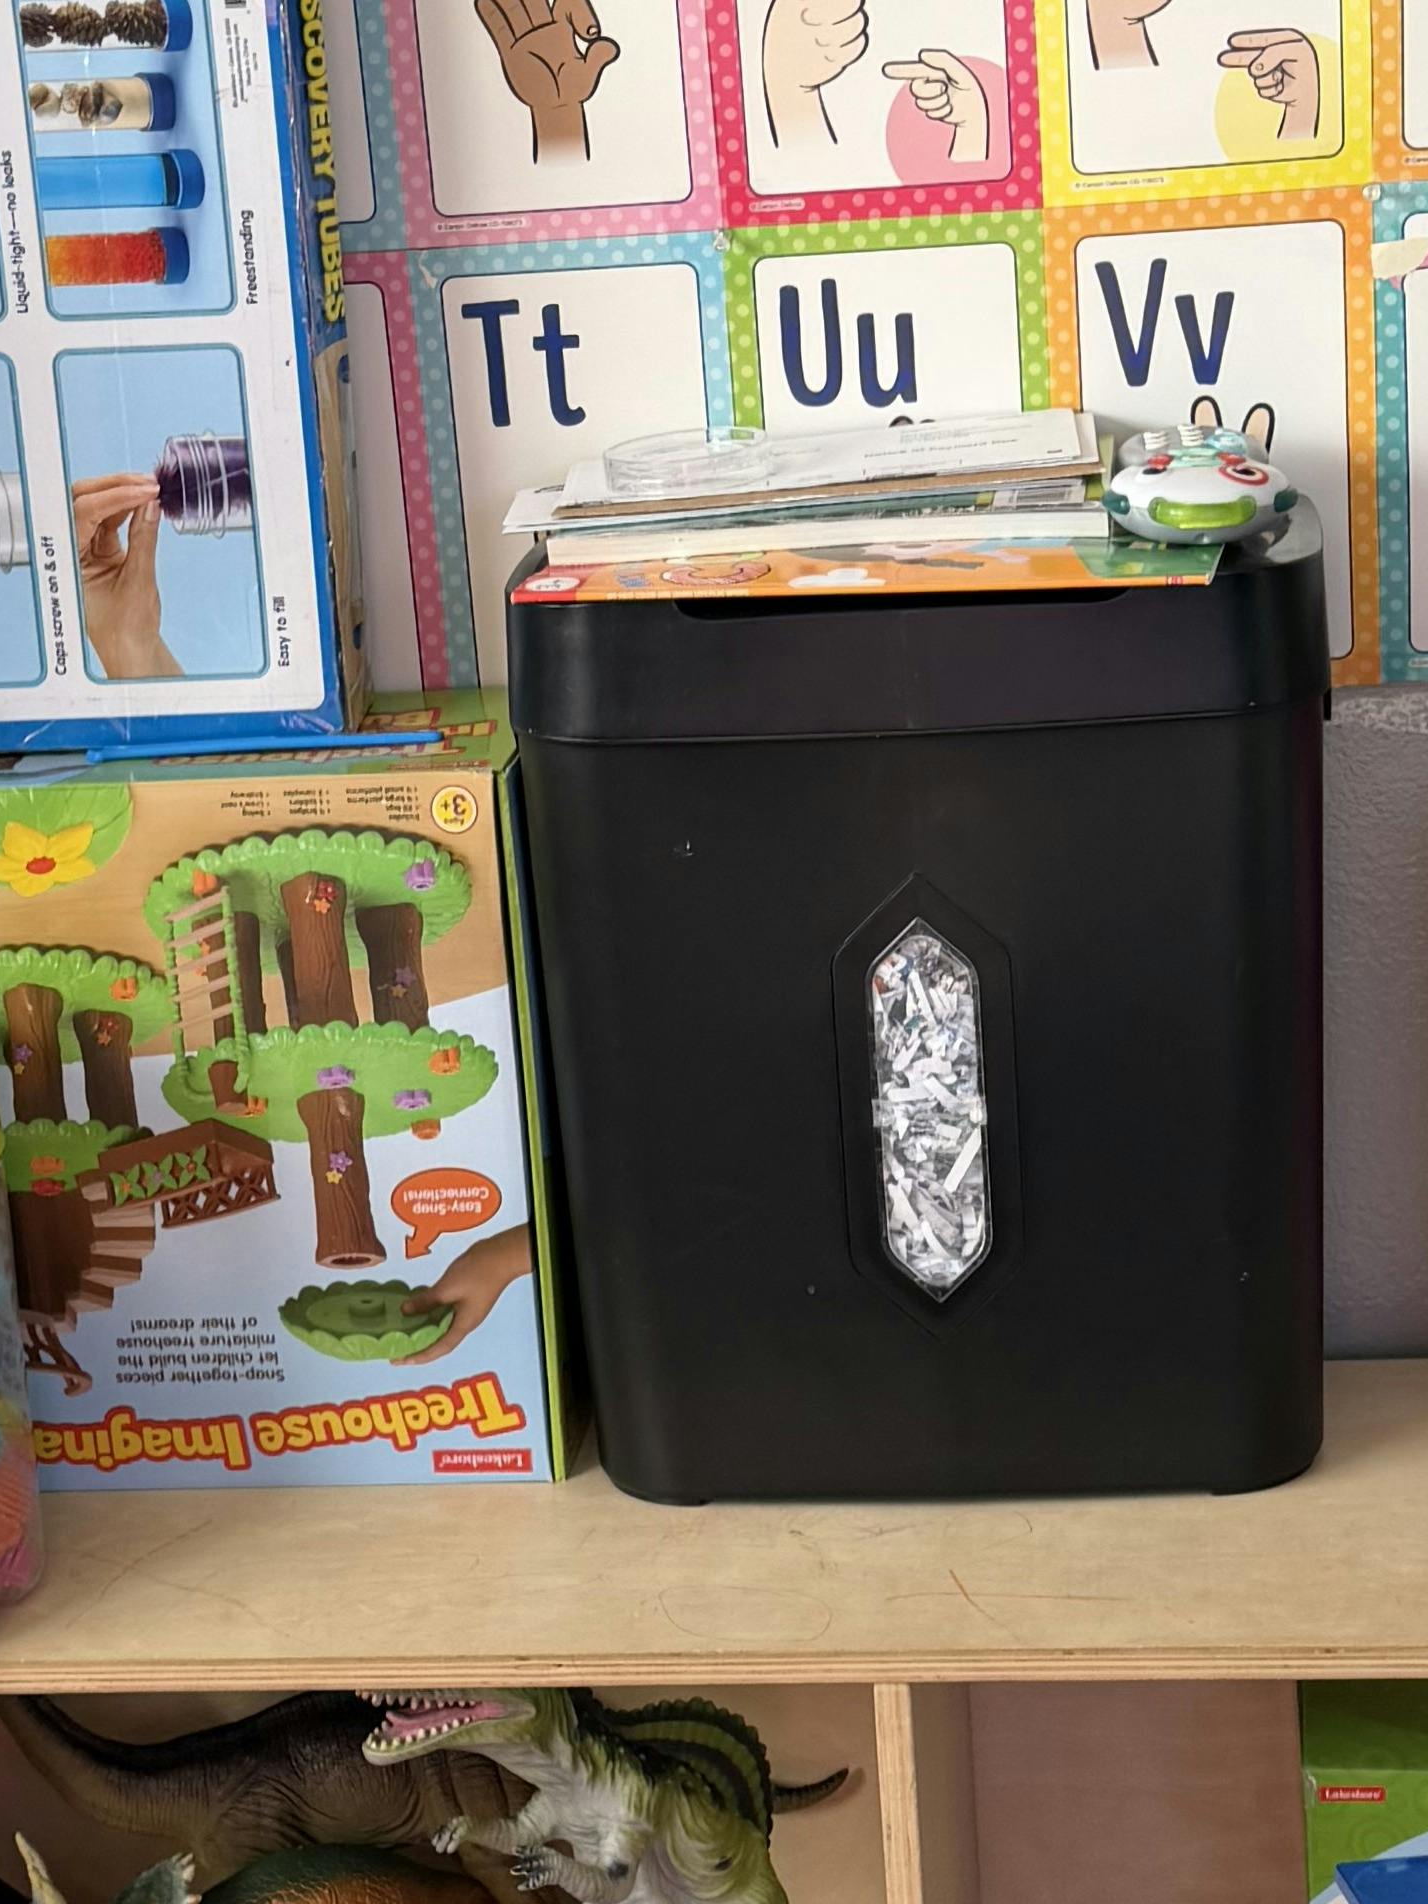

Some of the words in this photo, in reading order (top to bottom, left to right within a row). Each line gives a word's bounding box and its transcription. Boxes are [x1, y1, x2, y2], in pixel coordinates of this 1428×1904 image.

[0, 150, 14, 188] leaks
[238, 209, 257, 304] Freestanding
[314, 188, 346, 323] TUBES
[1094, 256, 1236, 388] Vv
[777, 278, 917, 408] Uu
[460, 299, 588, 428] Tt
[40, 535, 54, 557] off
[43, 560, 56, 571] &
[48, 575, 58, 593] on
[272, 596, 284, 612] fill
[50, 596, 63, 637] screw
[276, 616, 286, 631] to
[54, 640, 68, 675] Caps
[277, 635, 291, 667] Easy
[438, 792, 468, 817] 3+
[401, 1186, 490, 1202] Connections!
[410, 1198, 482, 1215] Easy-Snap
[129, 1317, 195, 1333] dreams!
[199, 1316, 236, 1332] their
[240, 1315, 258, 1331] of
[115, 1335, 195, 1351] treehouse
[198, 1332, 276, 1349] miniature
[117, 1353, 144, 1369] the
[147, 1353, 187, 1369] build
[190, 1350, 254, 1368] children
[258, 1350, 279, 1366] let
[114, 1368, 165, 1385] pieces
[169, 1366, 285, 1385] Snap-together
[249, 1375, 525, 1450] Treehouse
